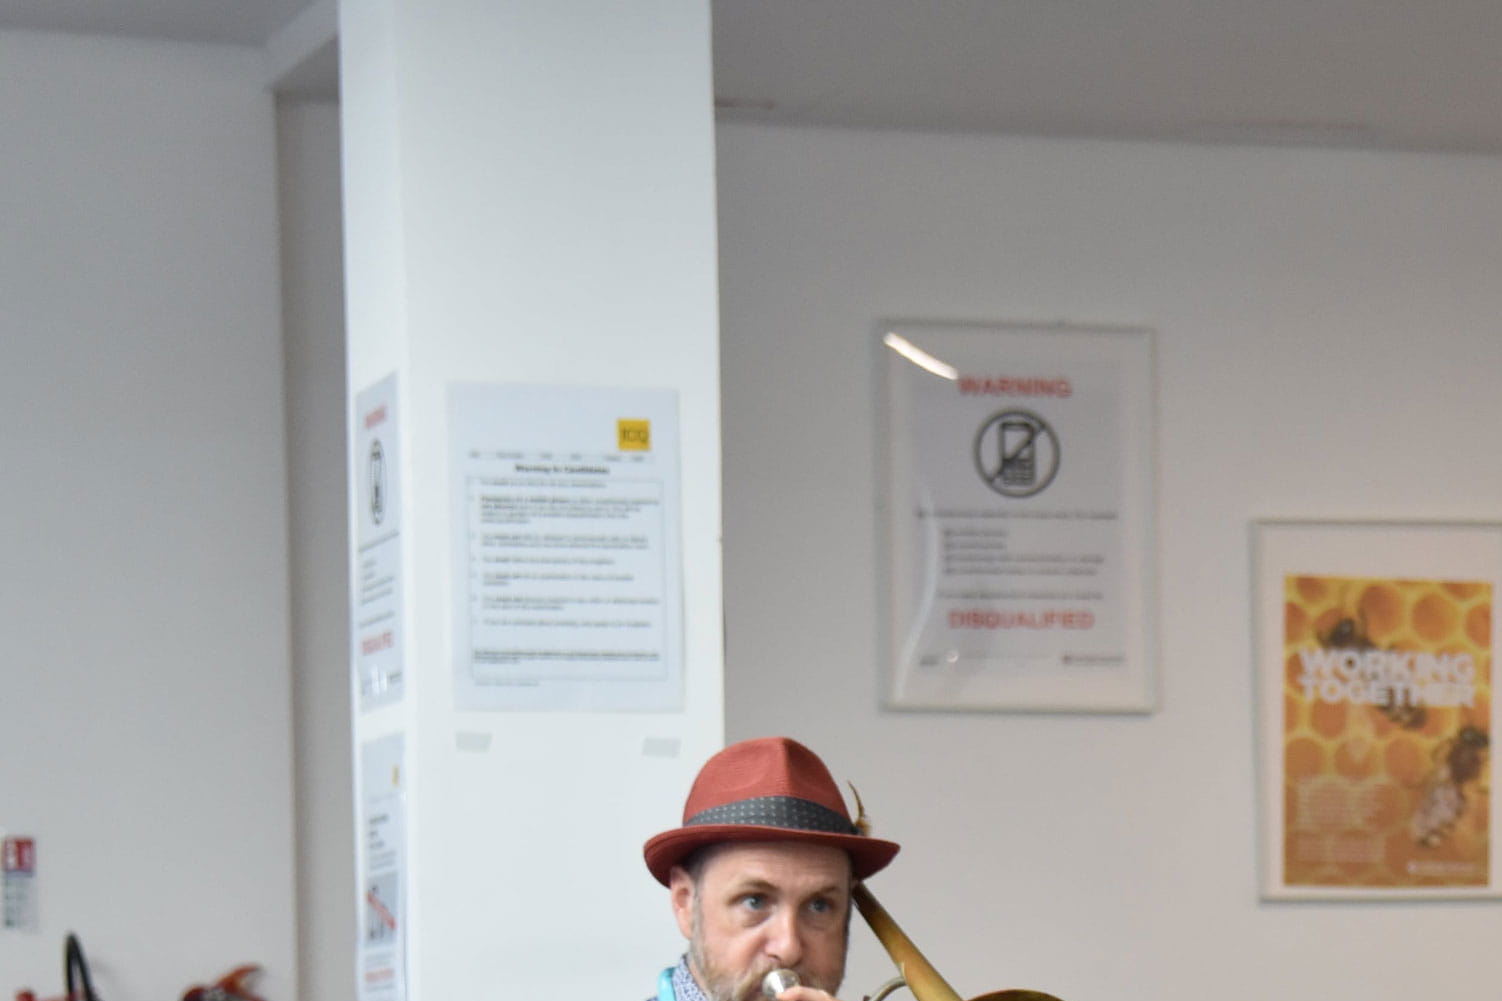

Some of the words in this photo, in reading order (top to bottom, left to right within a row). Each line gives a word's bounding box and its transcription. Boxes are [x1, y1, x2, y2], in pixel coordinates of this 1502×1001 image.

[957, 377, 1072, 398] WARNING
[948, 609, 1095, 630] DISQUALIFIED
[1300, 648, 1475, 688] WORKING
[1297, 675, 1476, 708] TOGETHER
